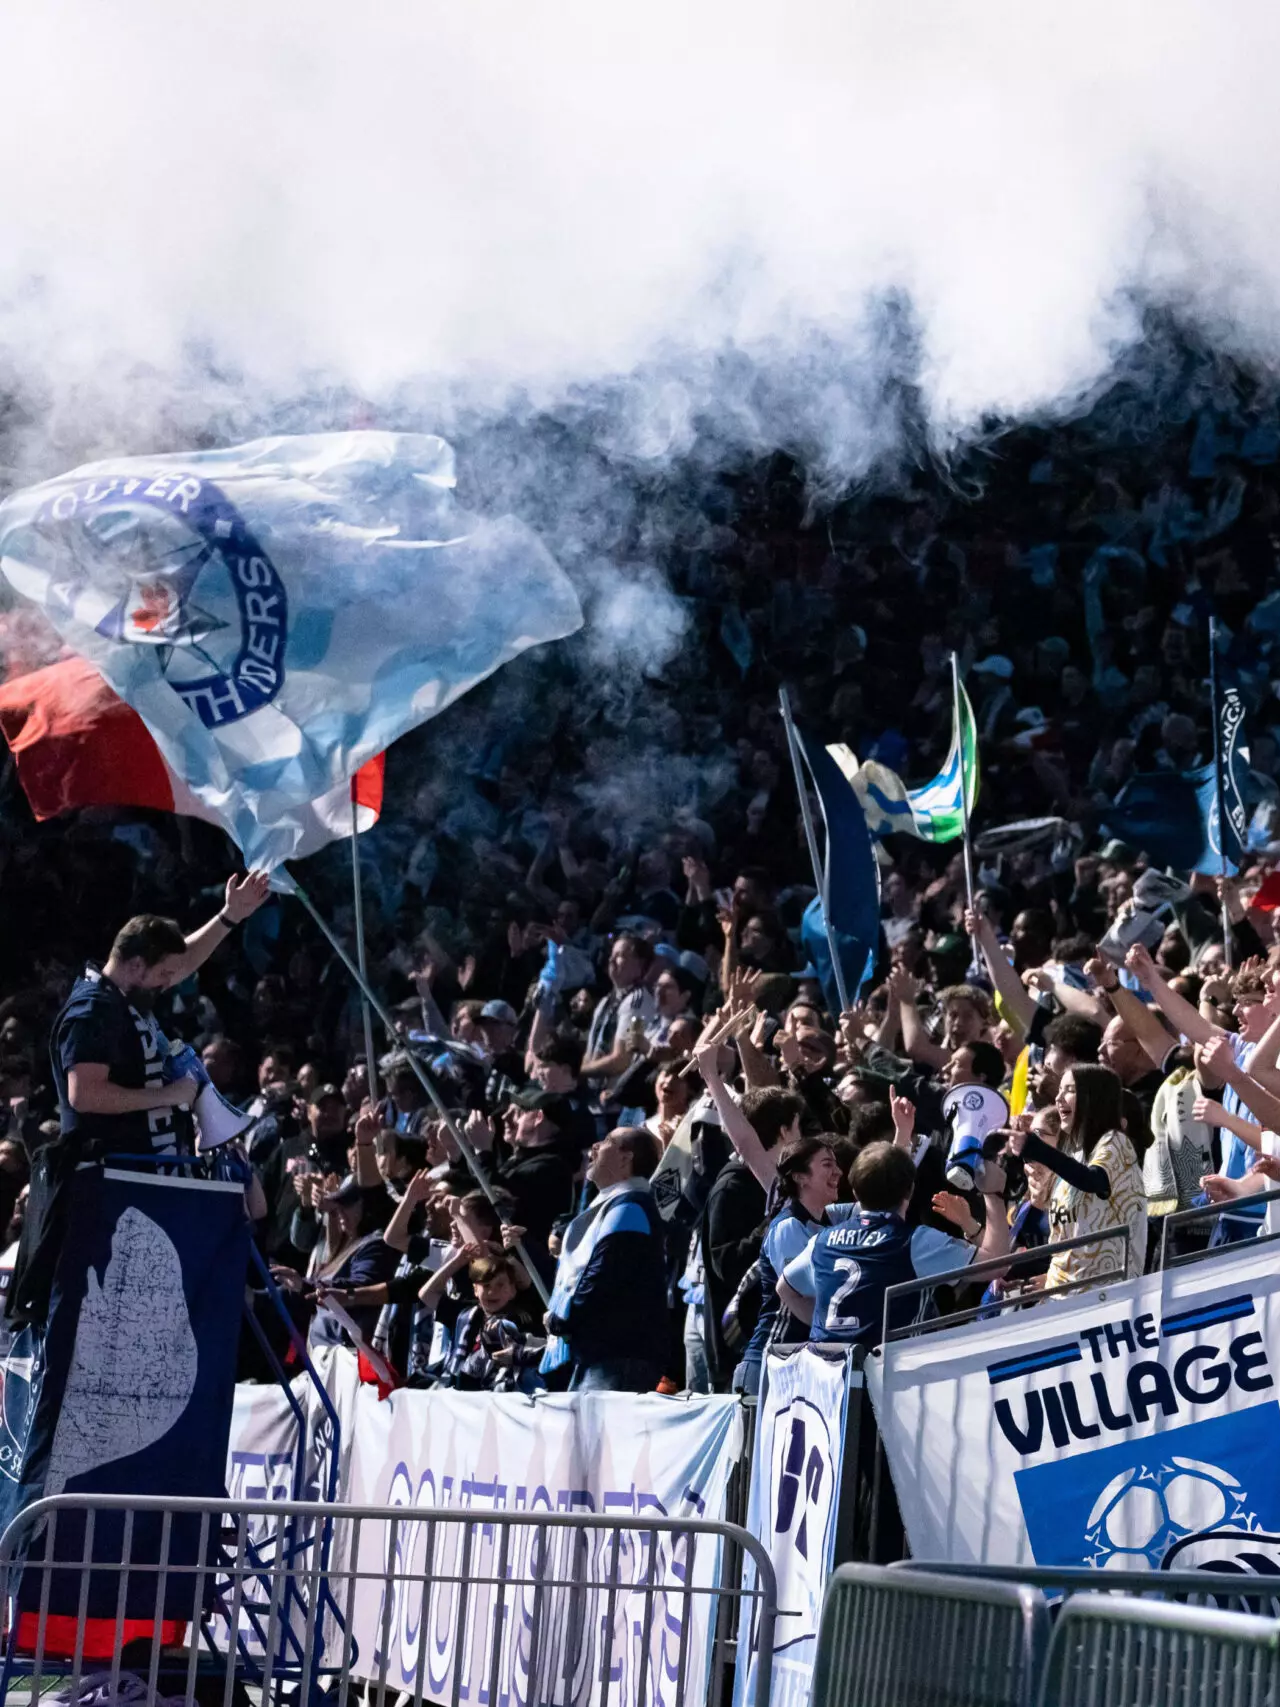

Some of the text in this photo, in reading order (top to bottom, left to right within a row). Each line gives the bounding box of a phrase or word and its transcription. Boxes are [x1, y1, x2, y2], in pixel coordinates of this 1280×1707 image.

[826, 1228, 887, 1247] HARVEY
[825, 1257, 861, 1329] 2
[1080, 1313, 1159, 1363] THE
[994, 1331, 1274, 1455] VILLAGE
